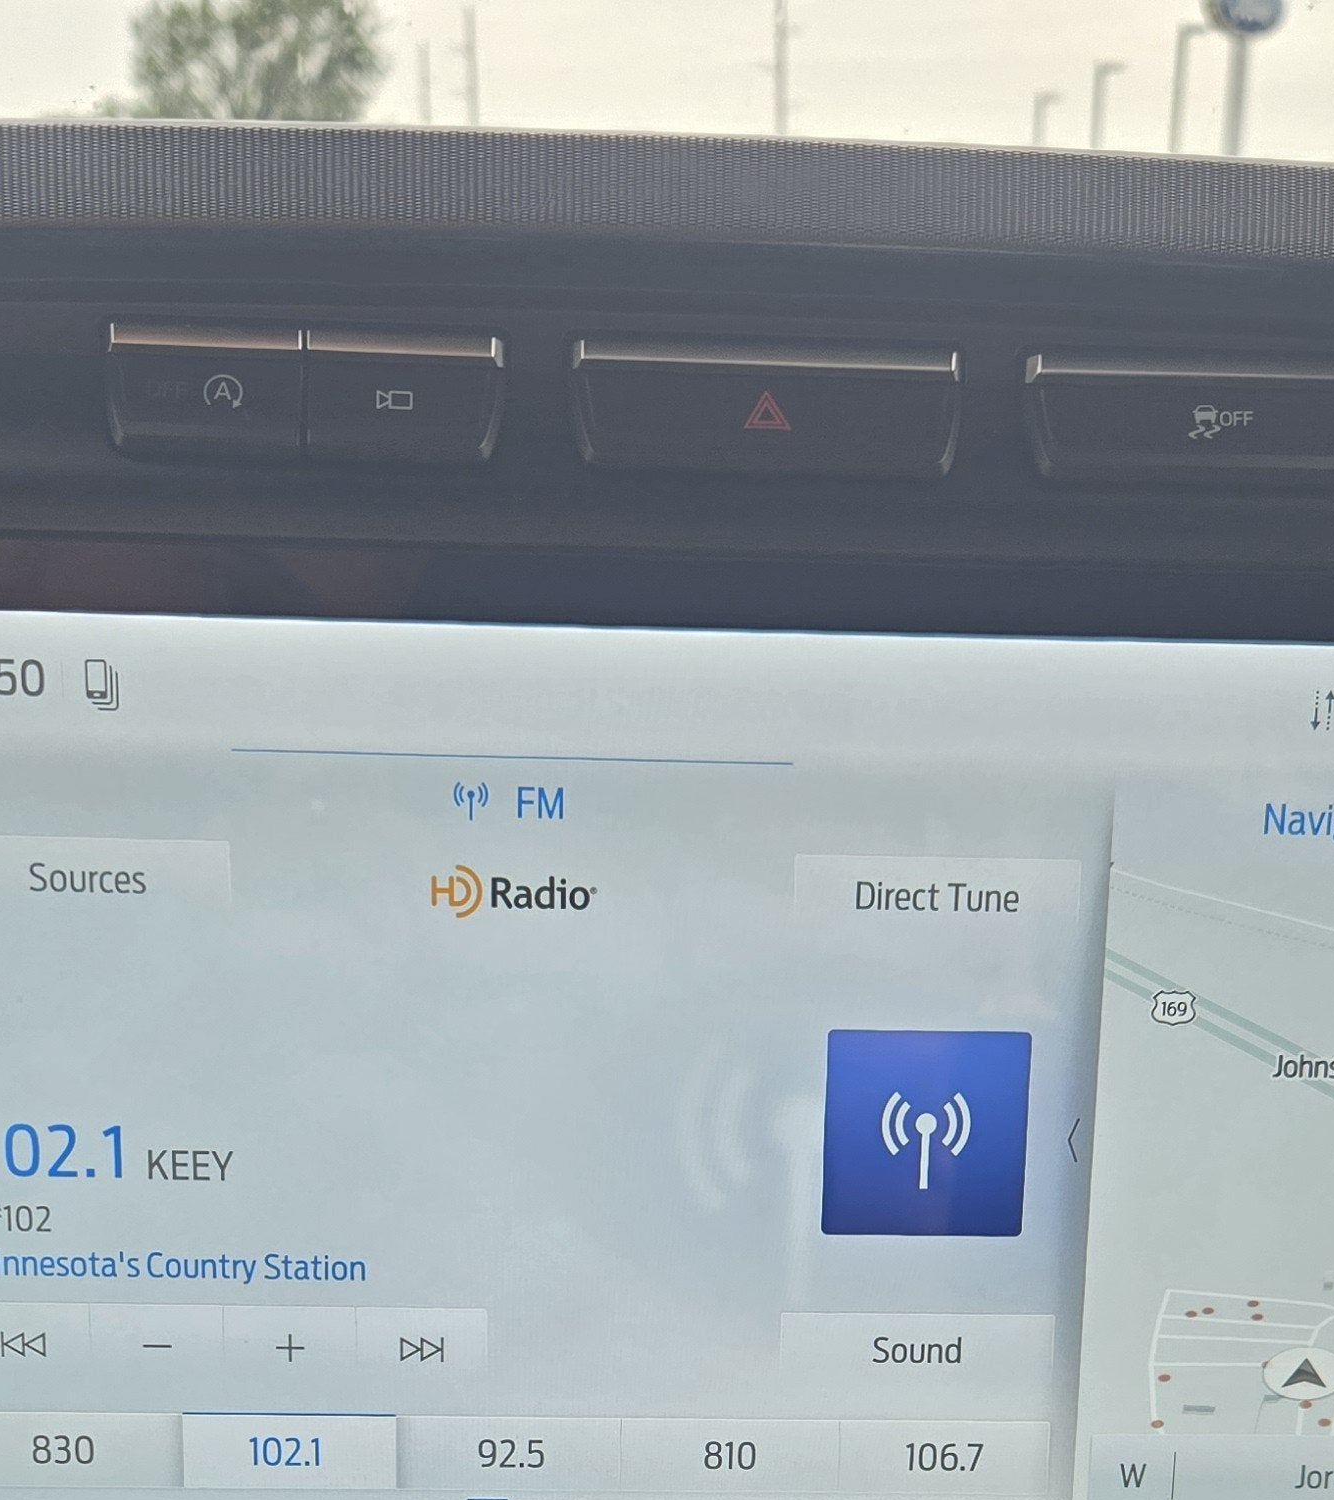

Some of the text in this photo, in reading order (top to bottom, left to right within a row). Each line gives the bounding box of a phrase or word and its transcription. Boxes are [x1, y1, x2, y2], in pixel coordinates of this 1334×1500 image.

[1220, 411, 1253, 427] OFF
[516, 786, 566, 821] FM
[27, 862, 148, 896] Sources
[431, 869, 479, 913] HD
[855, 881, 1020, 913] Direct Tune
[1160, 1000, 1188, 1019] 169
[146, 1150, 234, 1182] KEEY
[146, 1251, 257, 1284] Country
[264, 1253, 367, 1282] Station
[872, 1335, 963, 1367] Sound
[31, 1434, 95, 1465] 830
[248, 1436, 322, 1468] 102.1
[477, 1439, 546, 1470] 92.5
[704, 1441, 757, 1471] 810
[904, 1442, 984, 1473] 106.7
[1119, 1463, 1148, 1489] W
